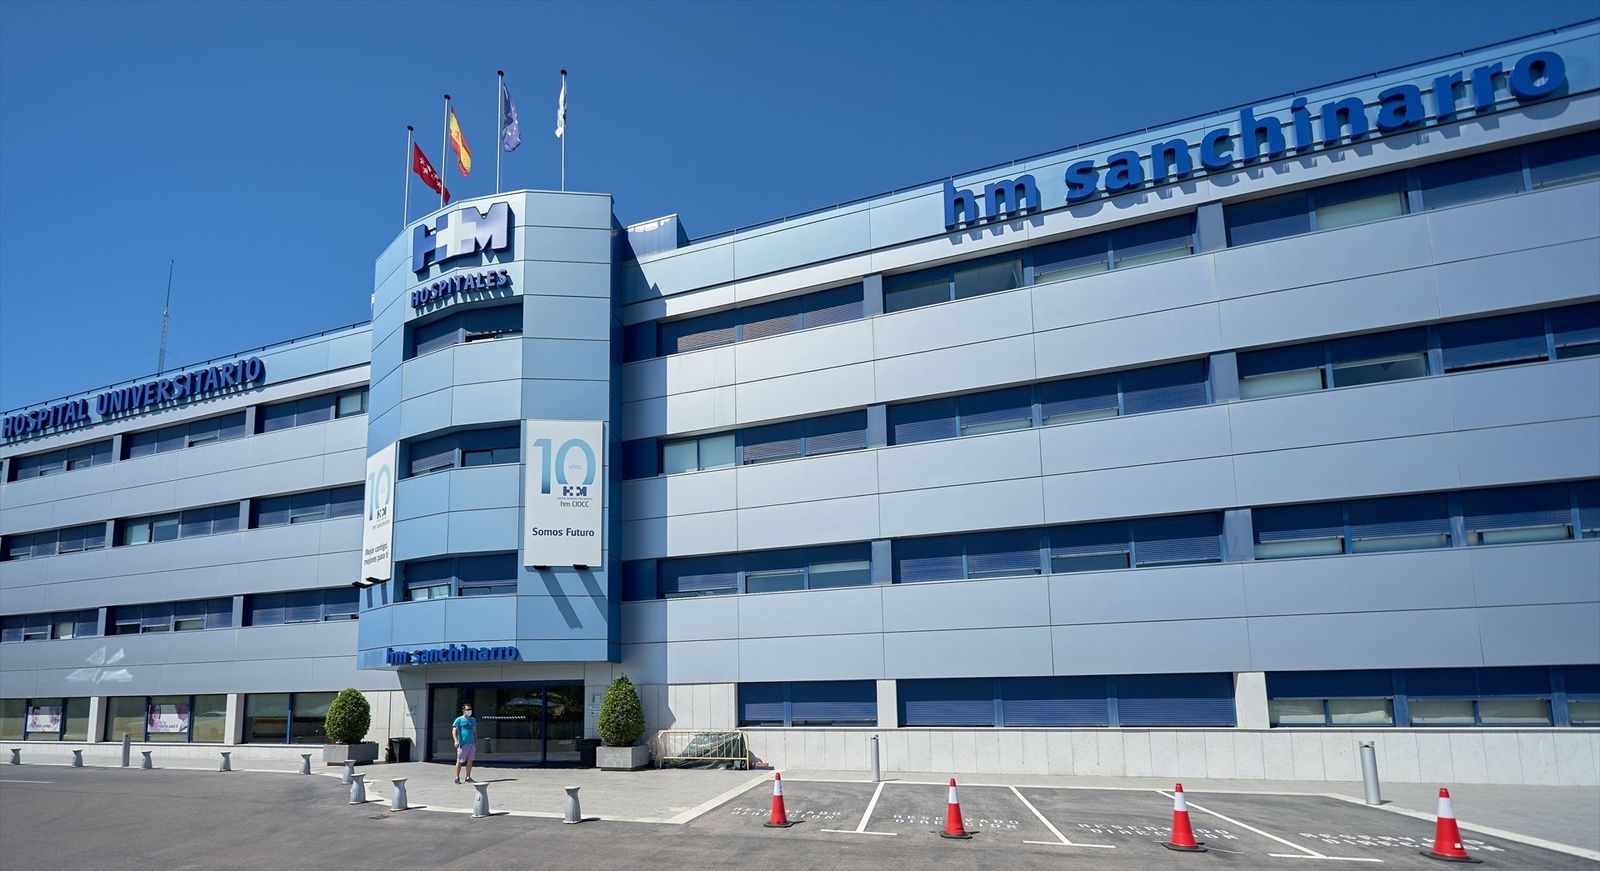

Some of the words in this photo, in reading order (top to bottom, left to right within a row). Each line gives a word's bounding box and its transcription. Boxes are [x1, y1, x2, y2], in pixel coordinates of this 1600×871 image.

[943, 178, 1039, 231] hm
[1064, 50, 1568, 202] sanchinarro
[410, 268, 508, 309] HOSPITALES
[2, 398, 89, 439] HOSPITAL
[96, 356, 265, 415] UNIVERSITARIO
[533, 438, 597, 495] 10
[368, 463, 392, 521] 10
[560, 500, 571, 508] hm
[571, 500, 590, 508] CIOCC
[532, 527, 564, 537] Somos
[566, 528, 595, 537] Futuro
[386, 647, 410, 666] hm
[412, 644, 519, 664] sanchinarro
[730, 811, 834, 820] DIRECION
[893, 814, 1019, 825] RESEVADO
[895, 819, 1017, 829] DIRECION
[1078, 823, 1230, 835] RESERVDO
[1090, 828, 1240, 840] DIRECION
[1299, 832, 1485, 846] RESERVAO
[1320, 838, 1505, 852] DIRECCON
